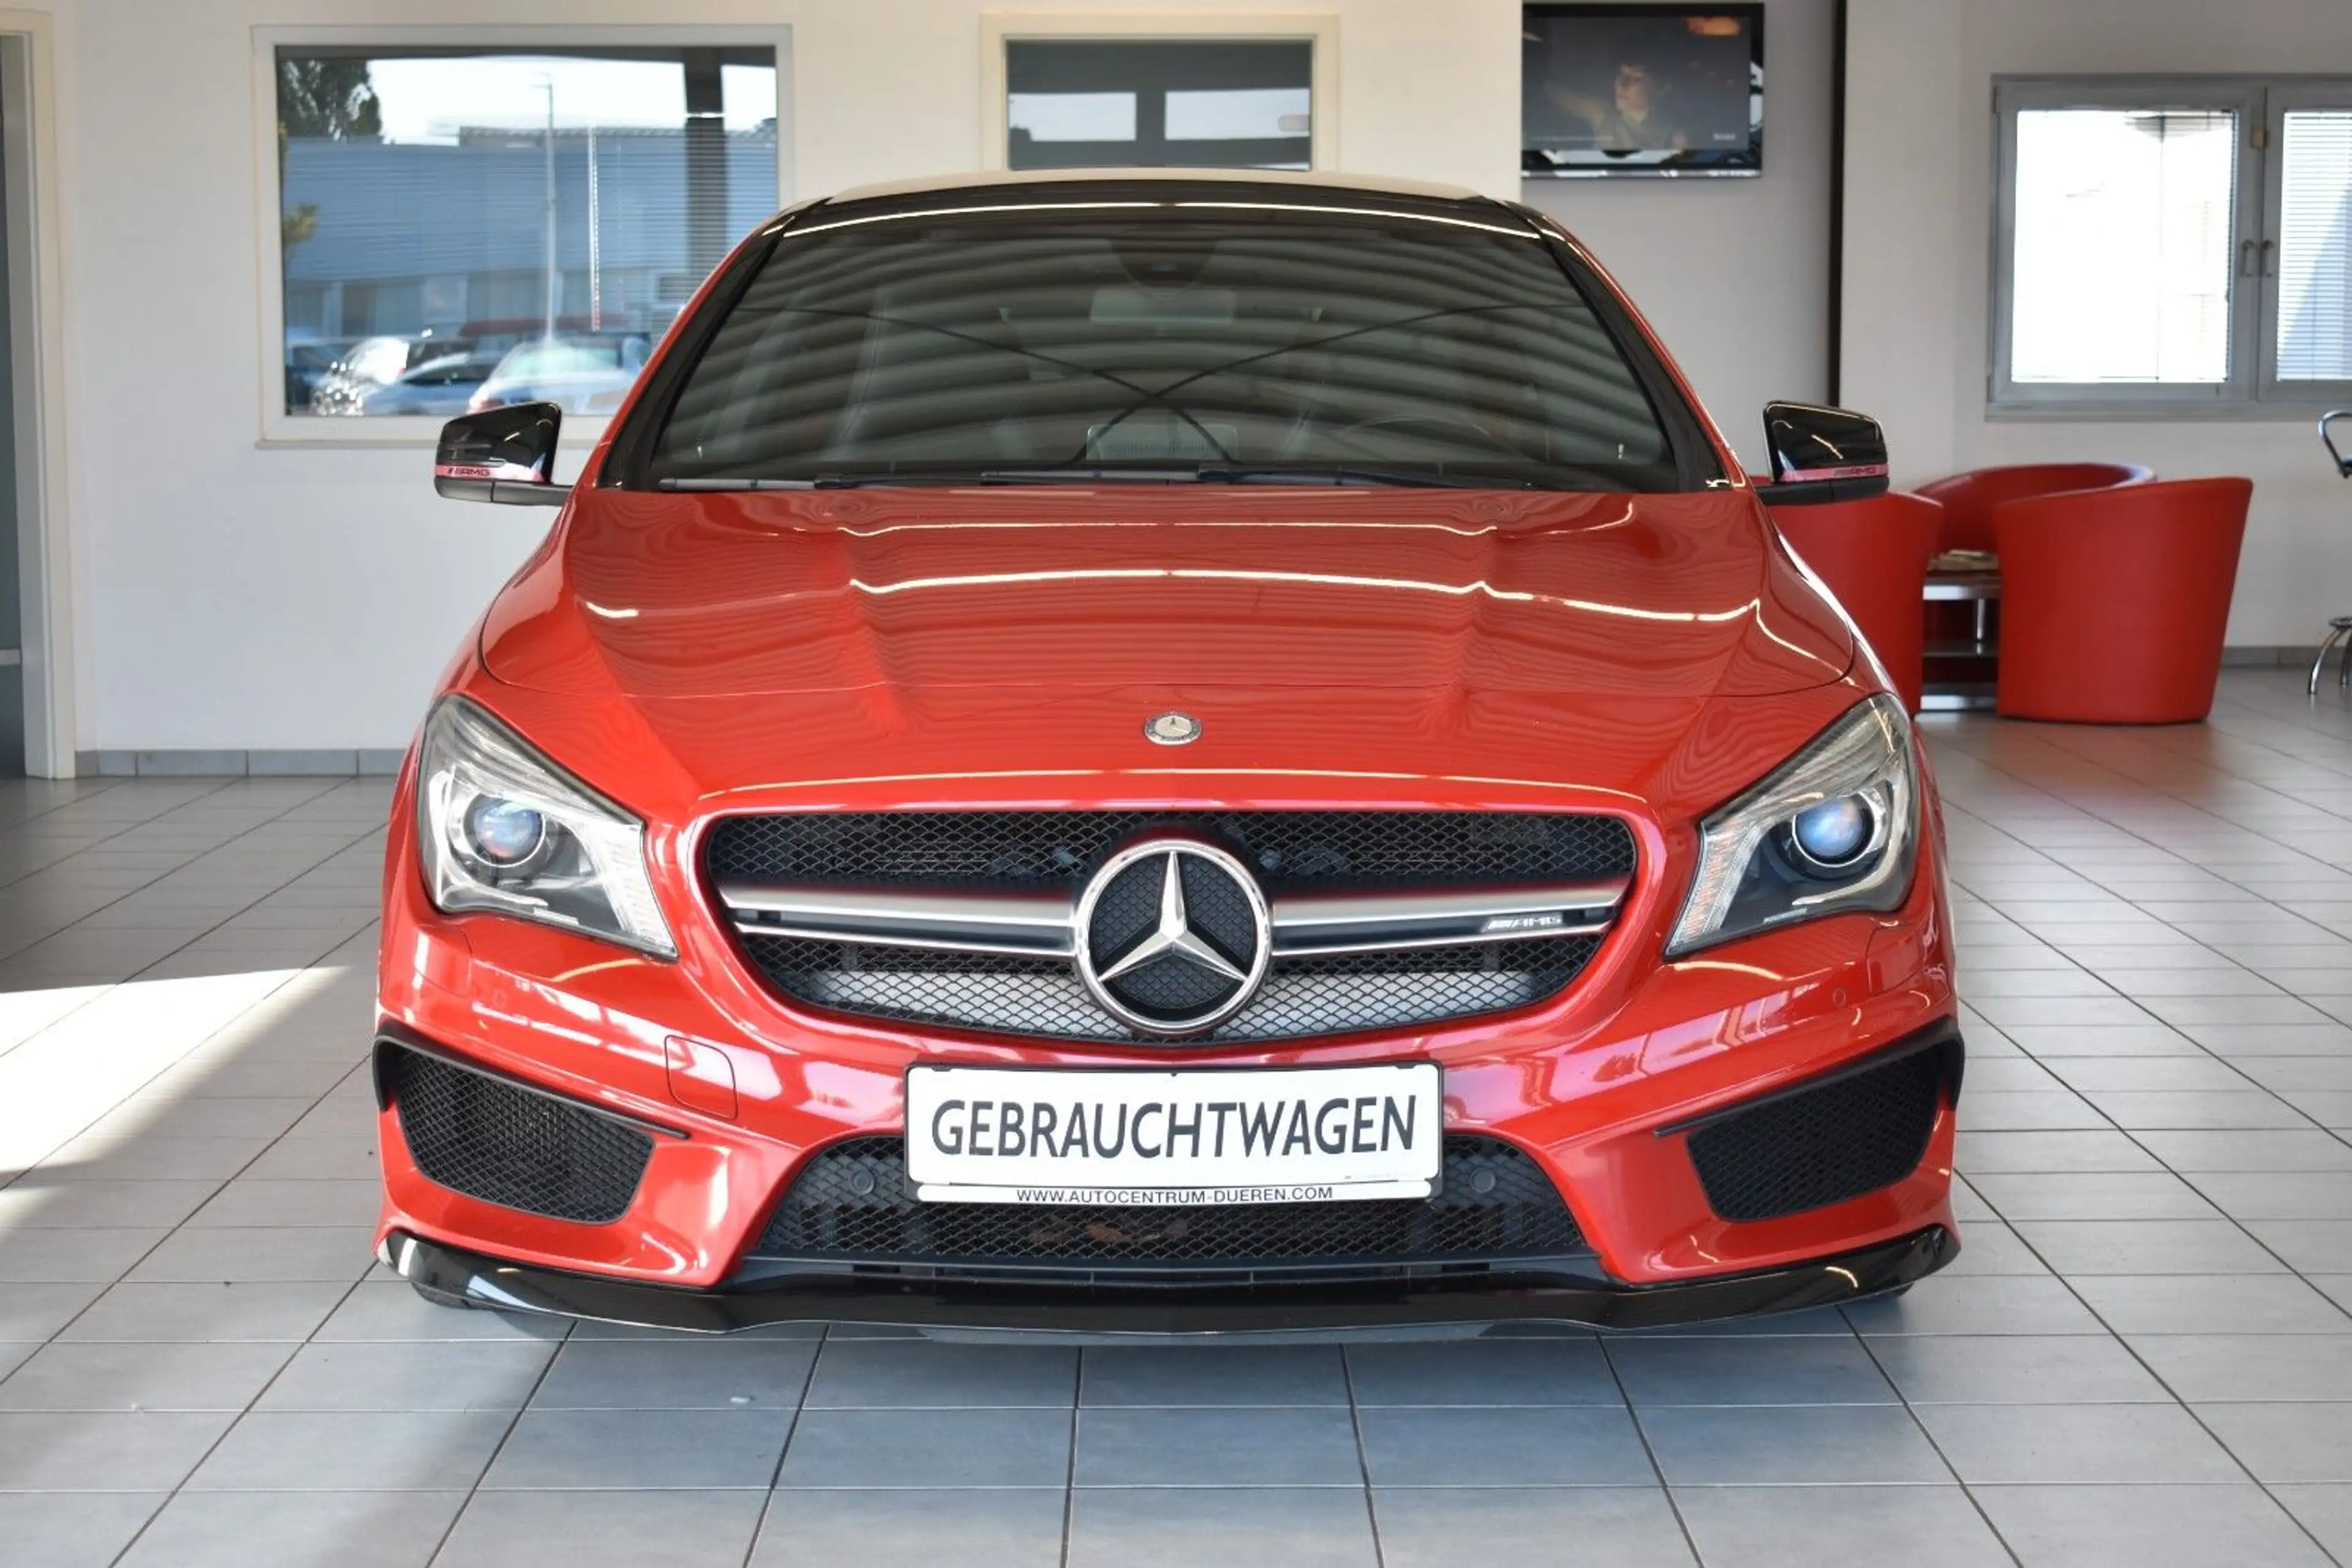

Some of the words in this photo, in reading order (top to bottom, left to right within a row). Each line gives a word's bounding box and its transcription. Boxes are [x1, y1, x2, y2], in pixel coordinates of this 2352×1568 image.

[460, 468, 490, 477] AMG
[932, 1095, 1417, 1159] GEBRAUCHTWAGEN
[1017, 1186, 1333, 1204] WWW.AUTOCENTRUM-DUEREN.COM
